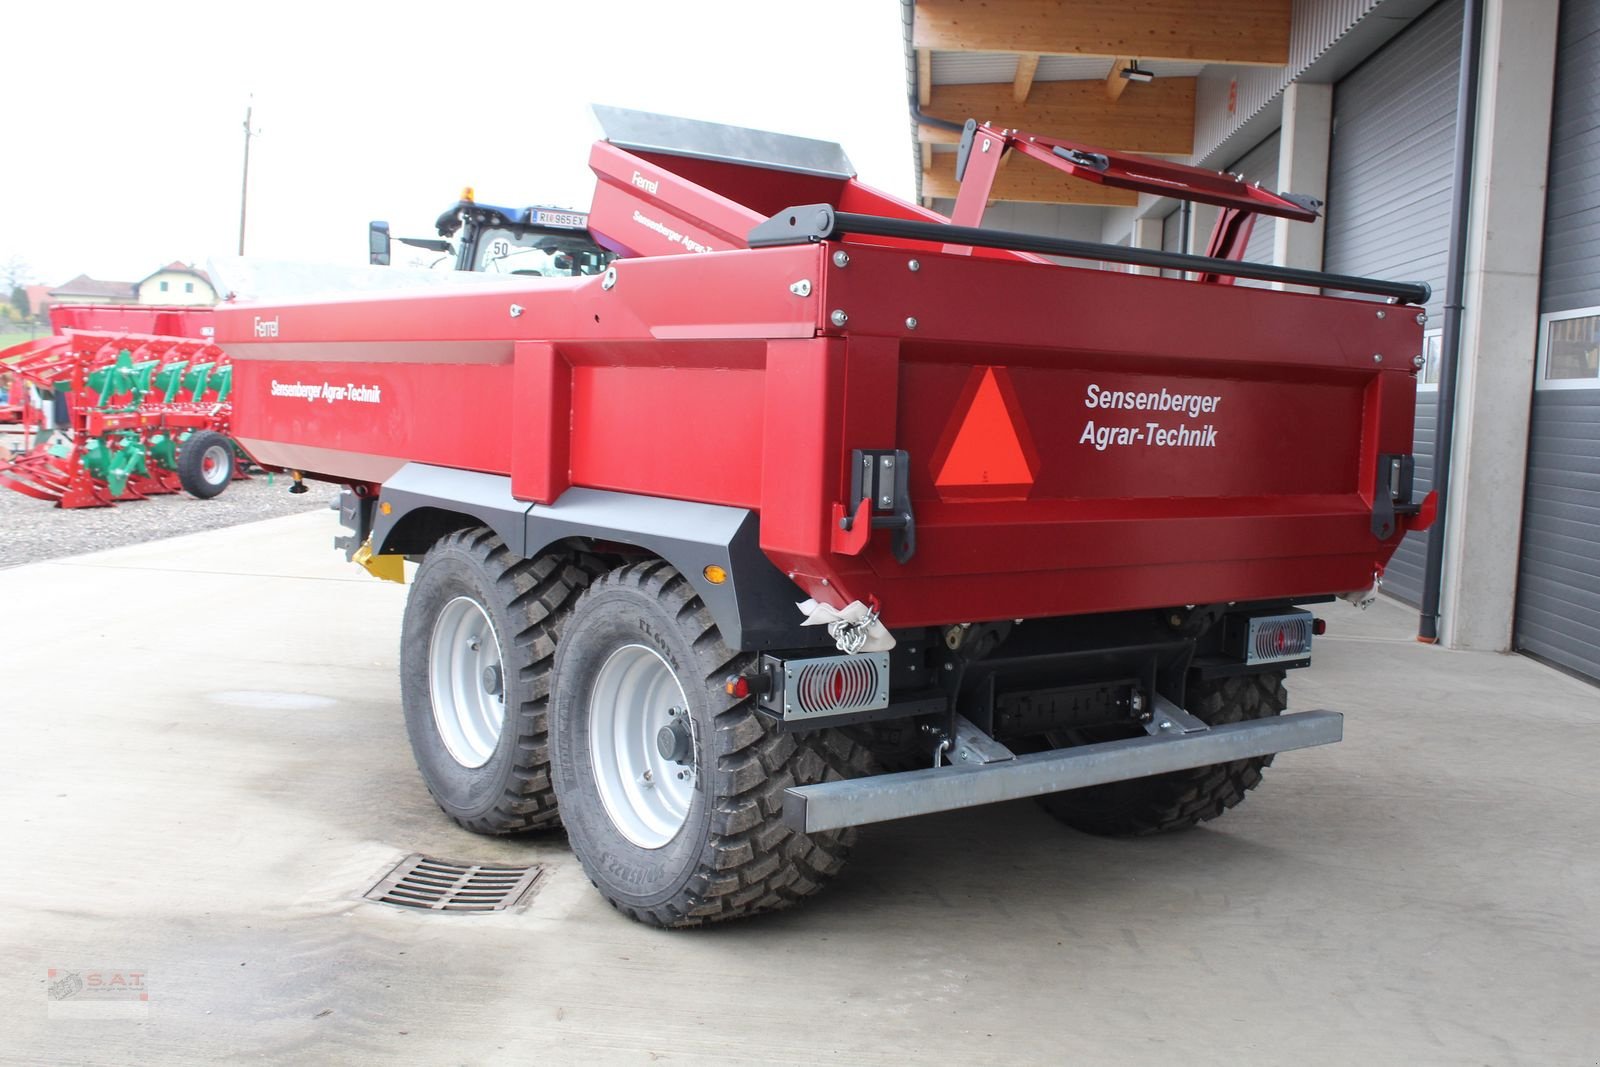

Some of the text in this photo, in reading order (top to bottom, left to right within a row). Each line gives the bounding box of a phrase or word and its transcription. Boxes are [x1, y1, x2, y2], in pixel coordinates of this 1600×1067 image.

[632, 171, 659, 194] Ferrel
[555, 214, 571, 225] 965
[572, 215, 585, 226] EX
[632, 210, 683, 242] Sensenberger
[493, 242, 509, 257] 50
[254, 315, 279, 337] Ferrel
[271, 379, 381, 403] Sensenberger Agrar-Technik
[1079, 383, 1222, 451] Sensenberger Agrar-Technik
